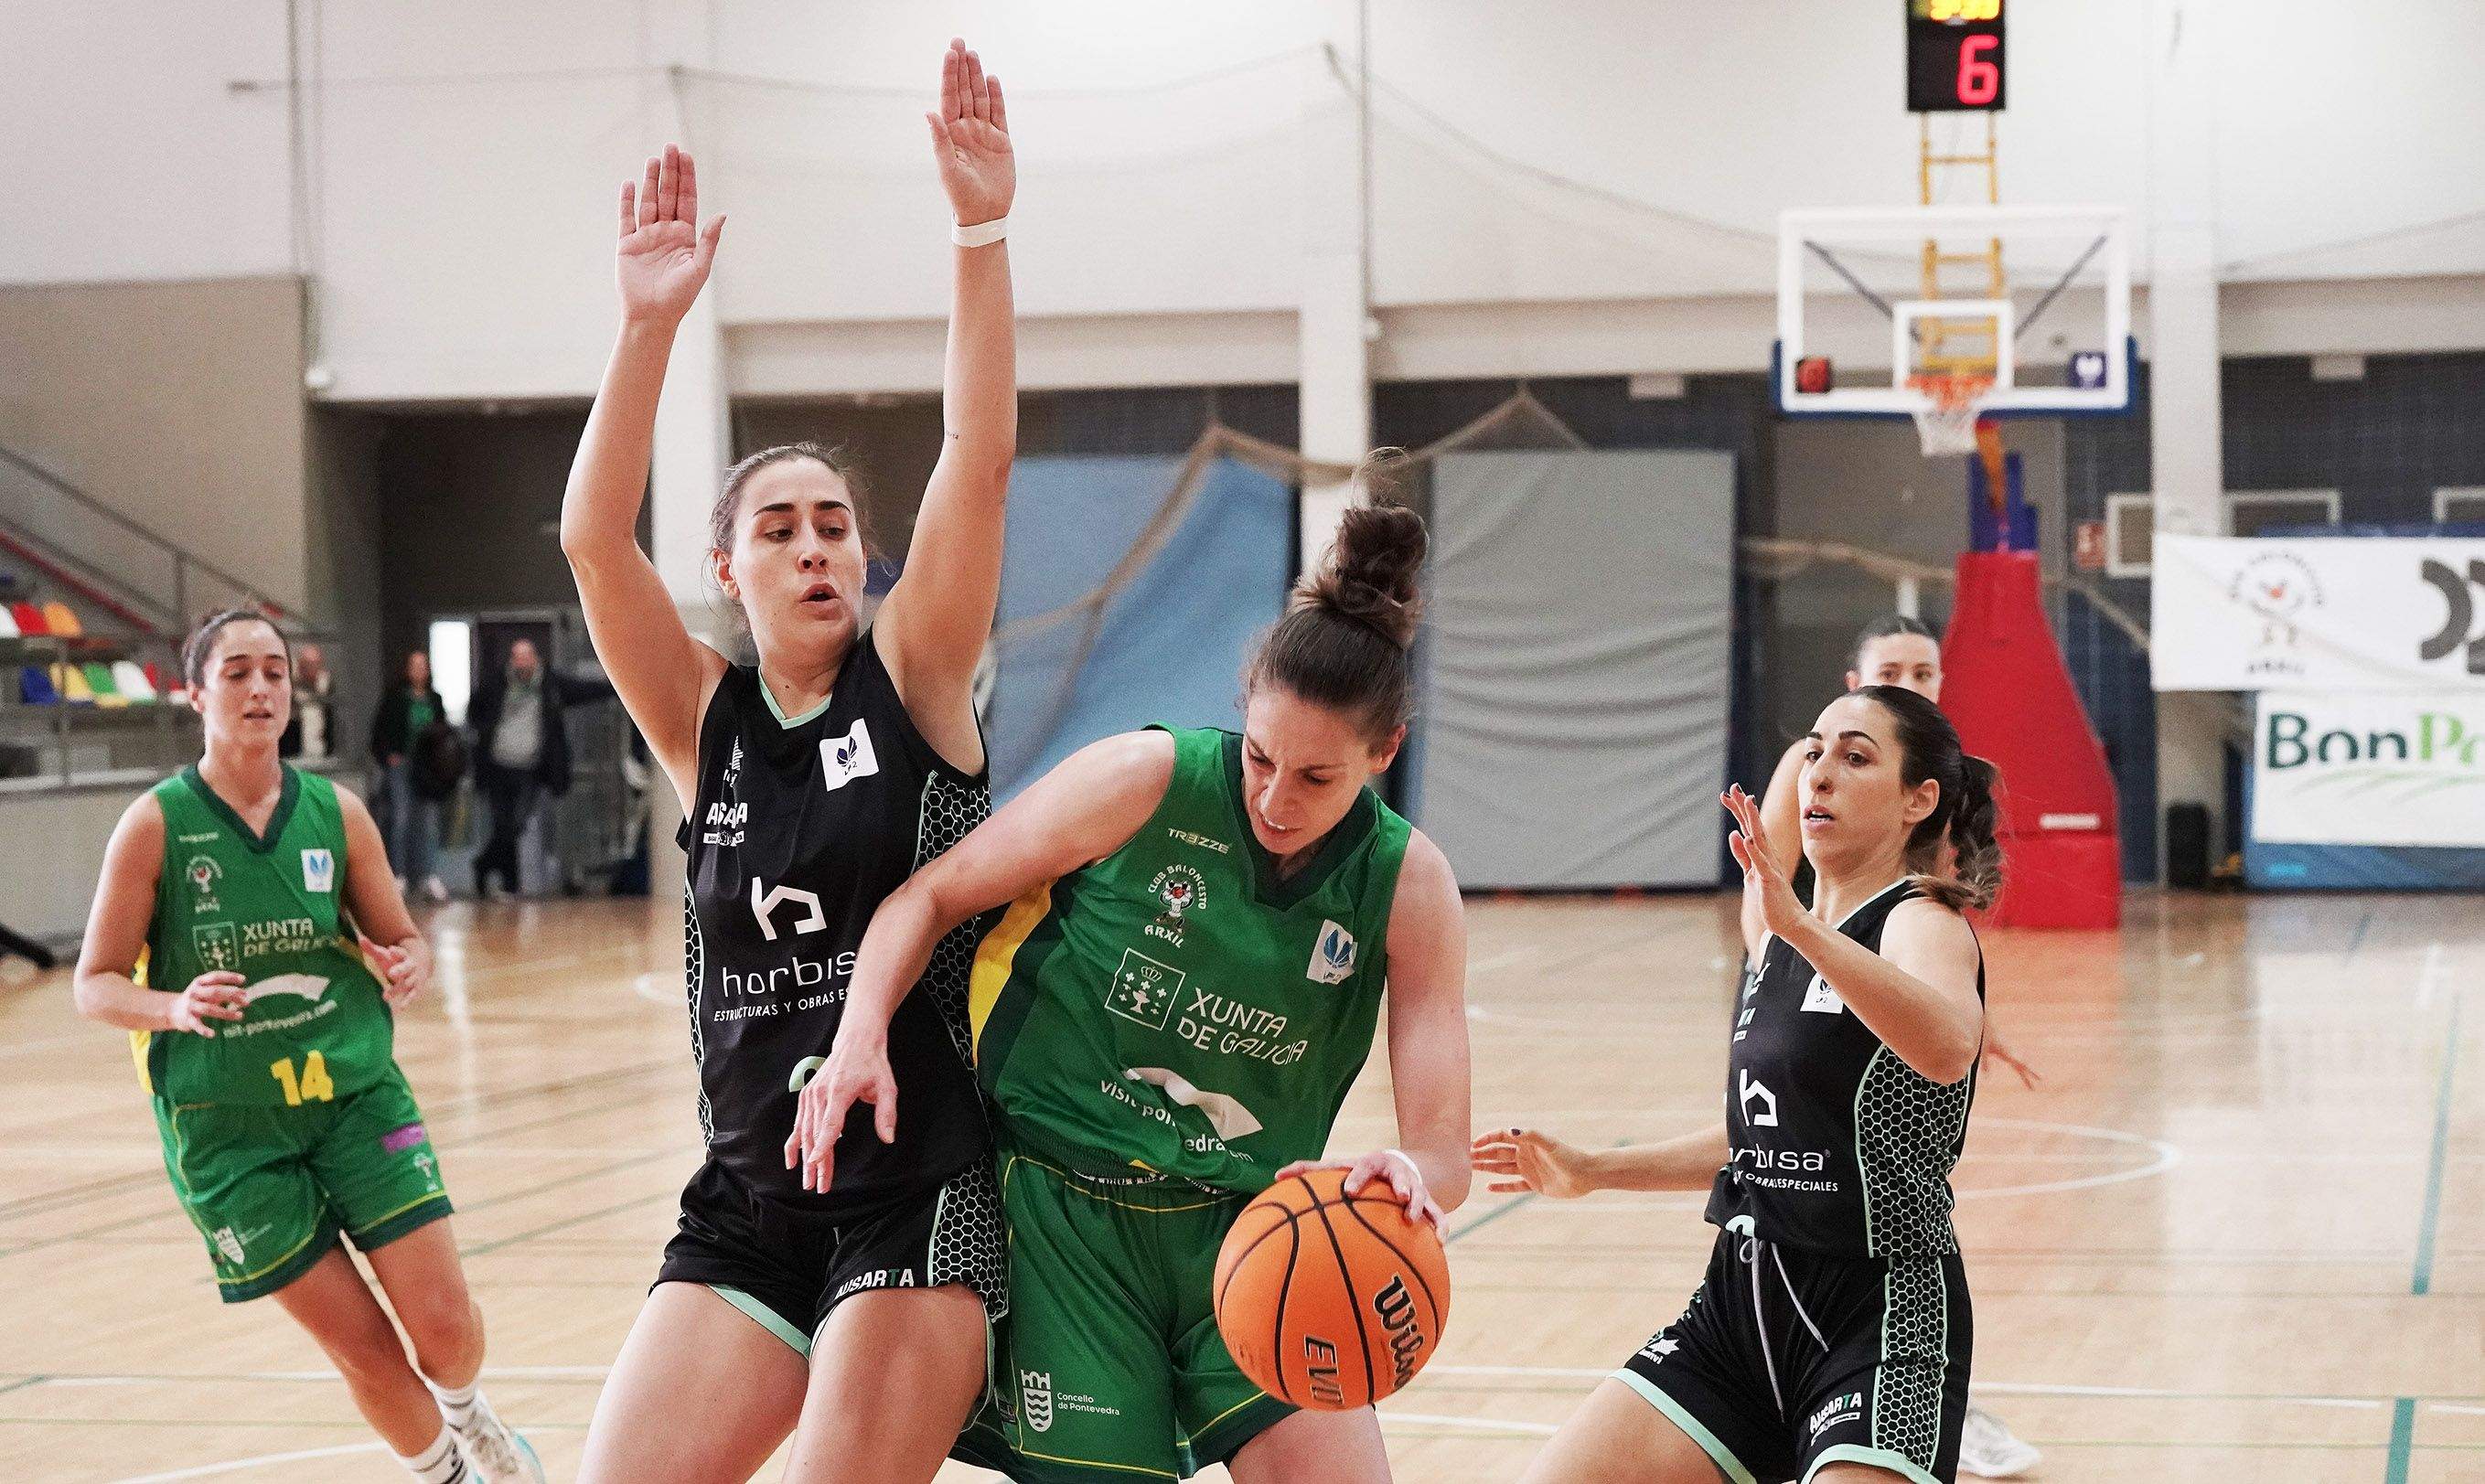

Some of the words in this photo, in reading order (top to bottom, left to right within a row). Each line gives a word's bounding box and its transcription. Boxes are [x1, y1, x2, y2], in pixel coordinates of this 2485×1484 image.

[1956, 34, 1999, 105] 6
[242, 917, 314, 942] XUNTA
[1143, 923, 1184, 949] ARXIL
[722, 951, 857, 998] horbis
[713, 1003, 778, 1022] ESTRUCTURAS
[783, 1000, 792, 1013] Y
[798, 990, 835, 1010] OBRAS
[1185, 987, 1288, 1039] XUNTA
[1176, 1016, 1218, 1051] DE
[1219, 1030, 1309, 1066] GALICIA
[270, 1049, 334, 1107] 14
[833, 1267, 916, 1302] AUSARTA
[1056, 1392, 1094, 1404] Concello
[1057, 1402, 1068, 1411] de
[1069, 1403, 1120, 1416] Pontevedra
